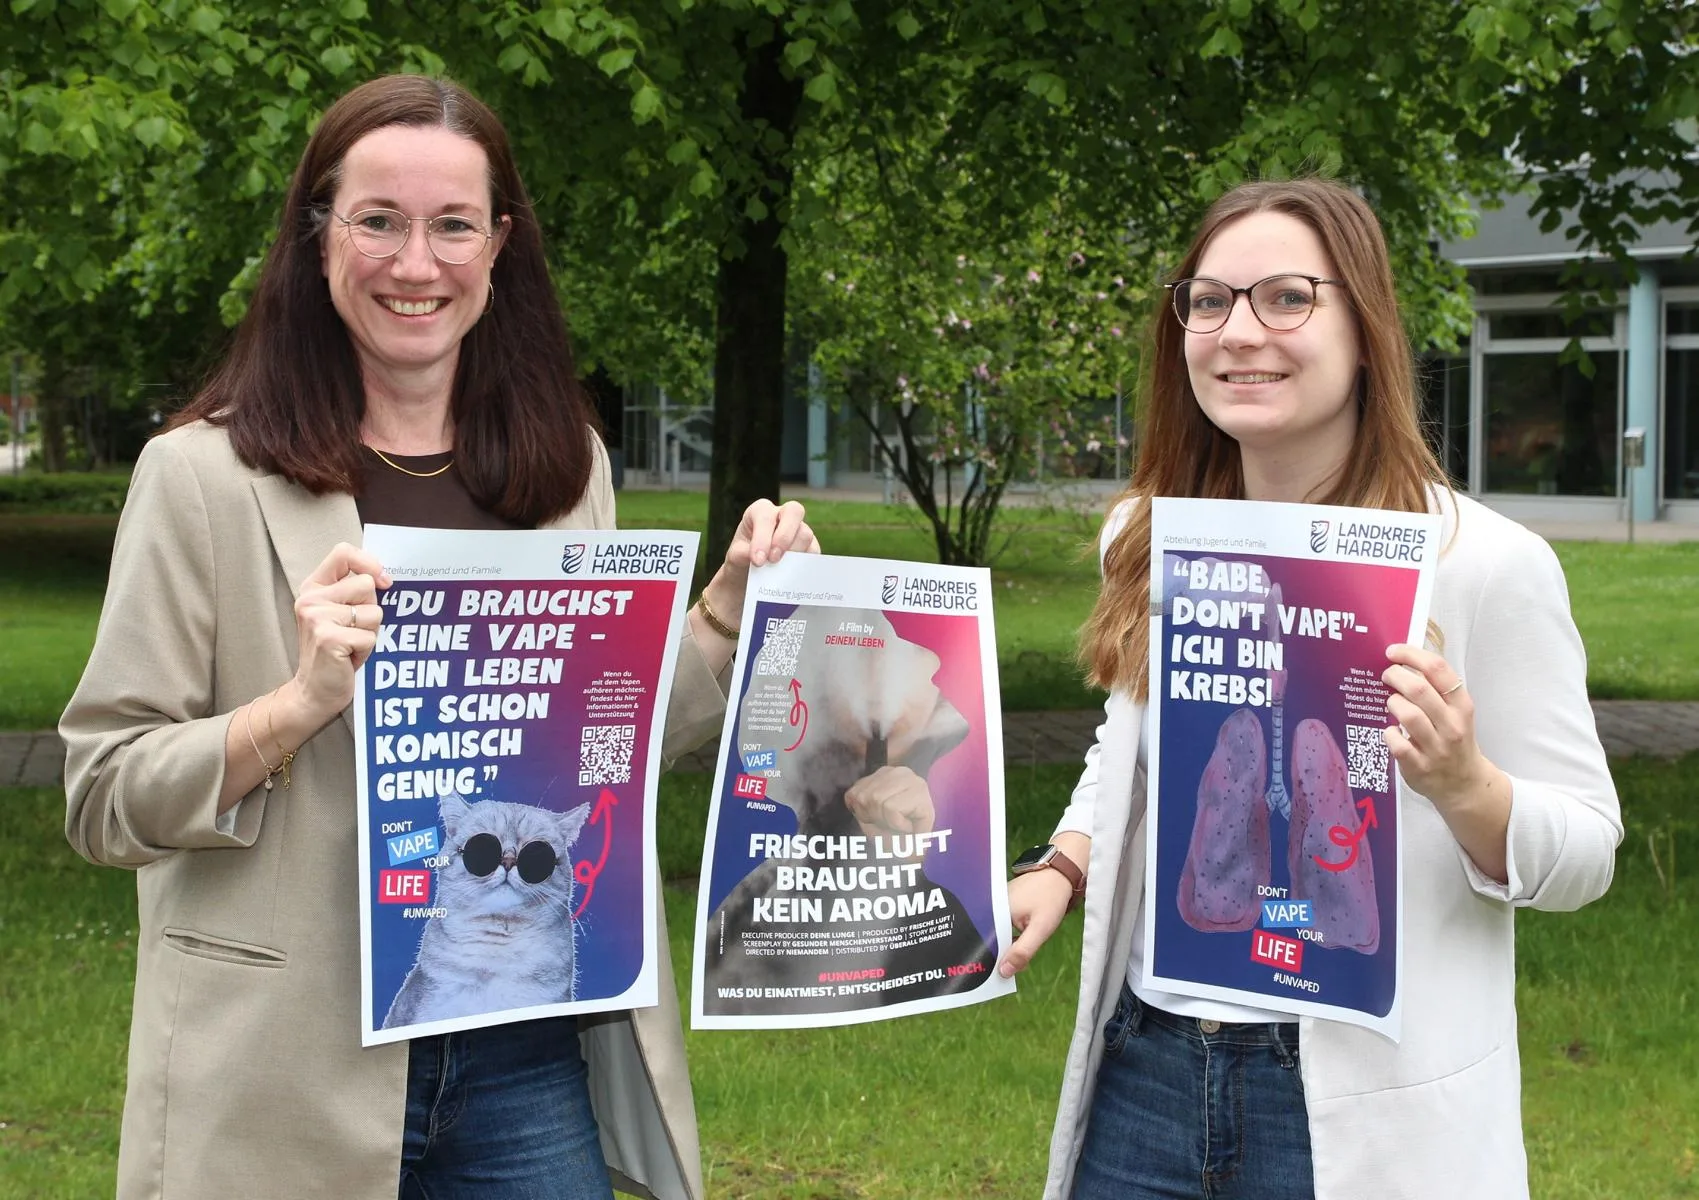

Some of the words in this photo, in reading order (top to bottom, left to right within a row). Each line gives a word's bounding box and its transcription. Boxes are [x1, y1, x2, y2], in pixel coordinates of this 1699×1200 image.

[1163, 536, 1201, 546] Abteilung
[1203, 537, 1228, 548] Jugend
[1230, 538, 1243, 546] und
[1338, 522, 1426, 544] LANDKREIS
[594, 544, 682, 558] LANDKREIS
[1336, 542, 1423, 563] HARBURG
[382, 566, 418, 576] bteilung
[420, 566, 450, 576] Jugend
[452, 566, 469, 575] und
[471, 566, 501, 574] Familie
[592, 559, 680, 575] HARBURG
[904, 577, 977, 595] LANDKREIS
[458, 589, 633, 616] BRAUCHST
[902, 593, 978, 610] HARBURG
[1172, 597, 1265, 631] DON’T
[375, 624, 471, 653] KEINE
[488, 623, 575, 650] VAPE
[838, 622, 846, 632] A
[846, 622, 861, 633] Film
[863, 624, 874, 636] by
[825, 635, 856, 646] DEINEM
[858, 637, 884, 648] LEBEN
[1171, 634, 1224, 666] ICH
[1238, 638, 1283, 672] BIN
[374, 659, 449, 690] DEIN
[464, 658, 564, 686] LEBEN
[1170, 671, 1273, 707] KREBS!
[375, 696, 423, 727] IST
[438, 693, 550, 723] SCHON
[375, 729, 522, 765] KOMISCH
[746, 753, 773, 768] VAPE
[764, 770, 781, 778] YOUR
[738, 778, 762, 794] LIFE
[746, 801, 776, 813] #UNVAPED
[381, 821, 413, 834] DON'T
[390, 833, 435, 859] VAPE
[749, 833, 867, 859] FRISCHE
[874, 829, 952, 859] LUFT
[422, 856, 450, 868] YOUR
[385, 875, 424, 897] LIFE
[777, 863, 922, 891] BRAUCHT
[1258, 885, 1288, 899] DON'T
[403, 907, 448, 919] #UNVAPED
[753, 897, 824, 923] KEIN
[829, 887, 947, 922] AROMA
[1265, 904, 1309, 922] VAPE
[862, 928, 898, 937] PRODUCED
[909, 920, 934, 930] FRISCHE
[936, 915, 950, 924] LUFT
[1296, 928, 1323, 942] YOUR
[830, 935, 902, 946] MENSCHENVERSTAND
[909, 929, 928, 938] STORY
[836, 946, 878, 954] DISTRIBUTED
[890, 938, 918, 949] ÜBERALL
[919, 930, 952, 943] DRAUSSEN
[1257, 935, 1296, 965] LIFE
[718, 987, 744, 999] WAS
[746, 988, 762, 998] DU
[764, 986, 837, 998] EINATMEST,
[838, 973, 923, 996] ENTSCHEIDEST
[925, 969, 946, 982] DU.
[948, 962, 986, 977] NOCH.
[818, 968, 885, 983] #UNVAPED
[1273, 973, 1319, 992] #UNVAPED
